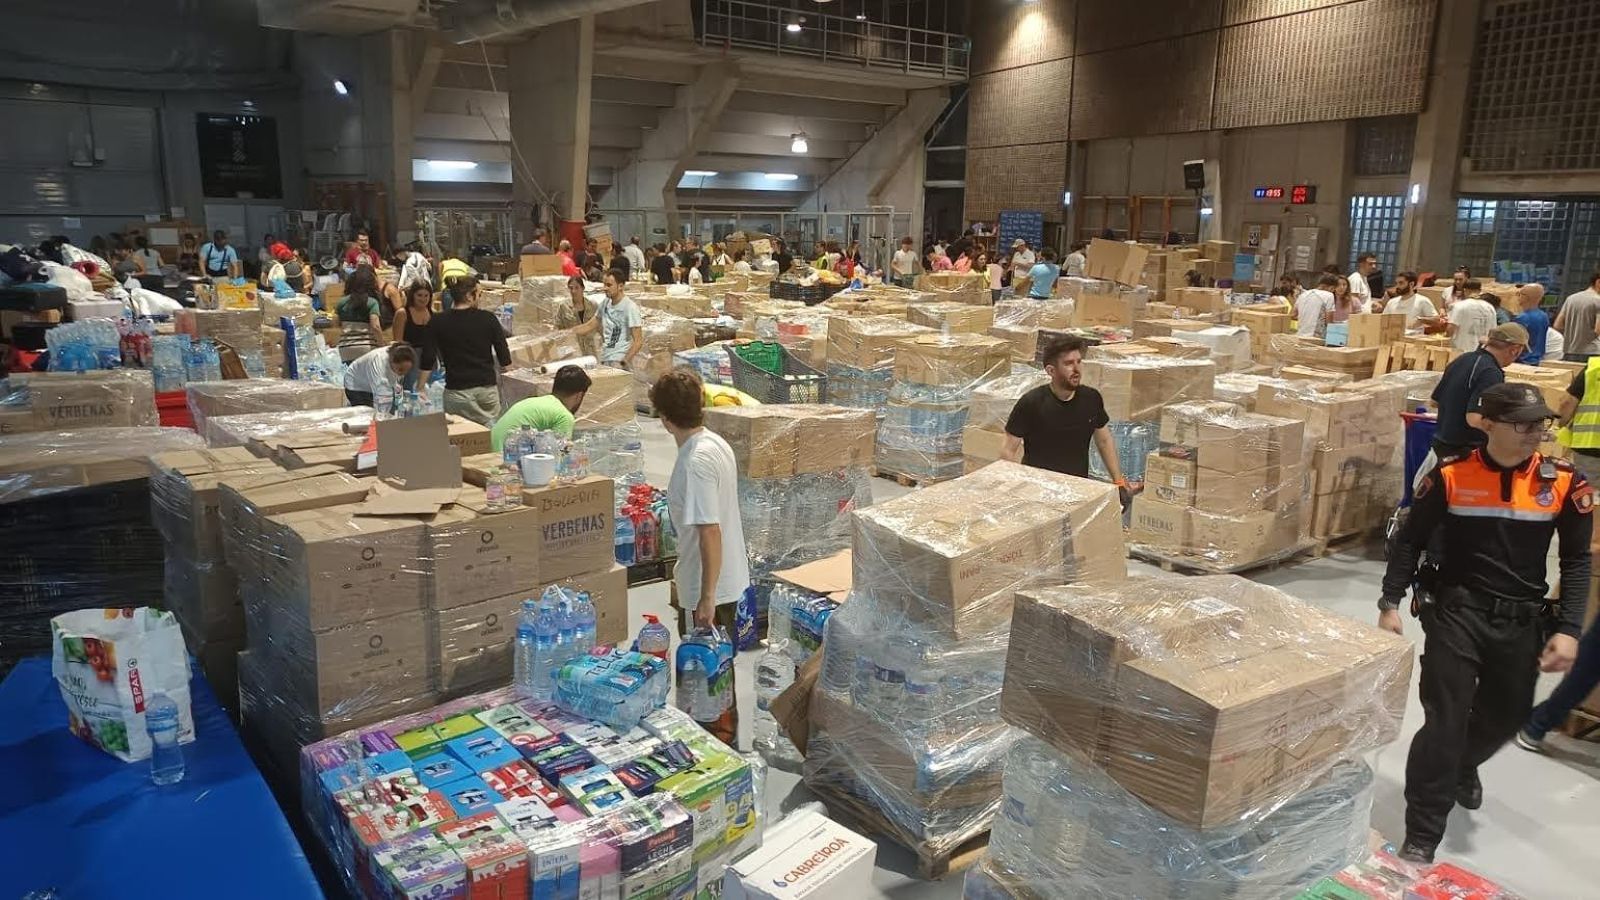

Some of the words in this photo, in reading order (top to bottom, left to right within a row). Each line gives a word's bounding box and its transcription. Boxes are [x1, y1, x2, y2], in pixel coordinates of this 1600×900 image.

[49, 404, 114, 419] VERBENAS
[542, 512, 605, 541] VERBENAS
[130, 669, 144, 705] SPAR
